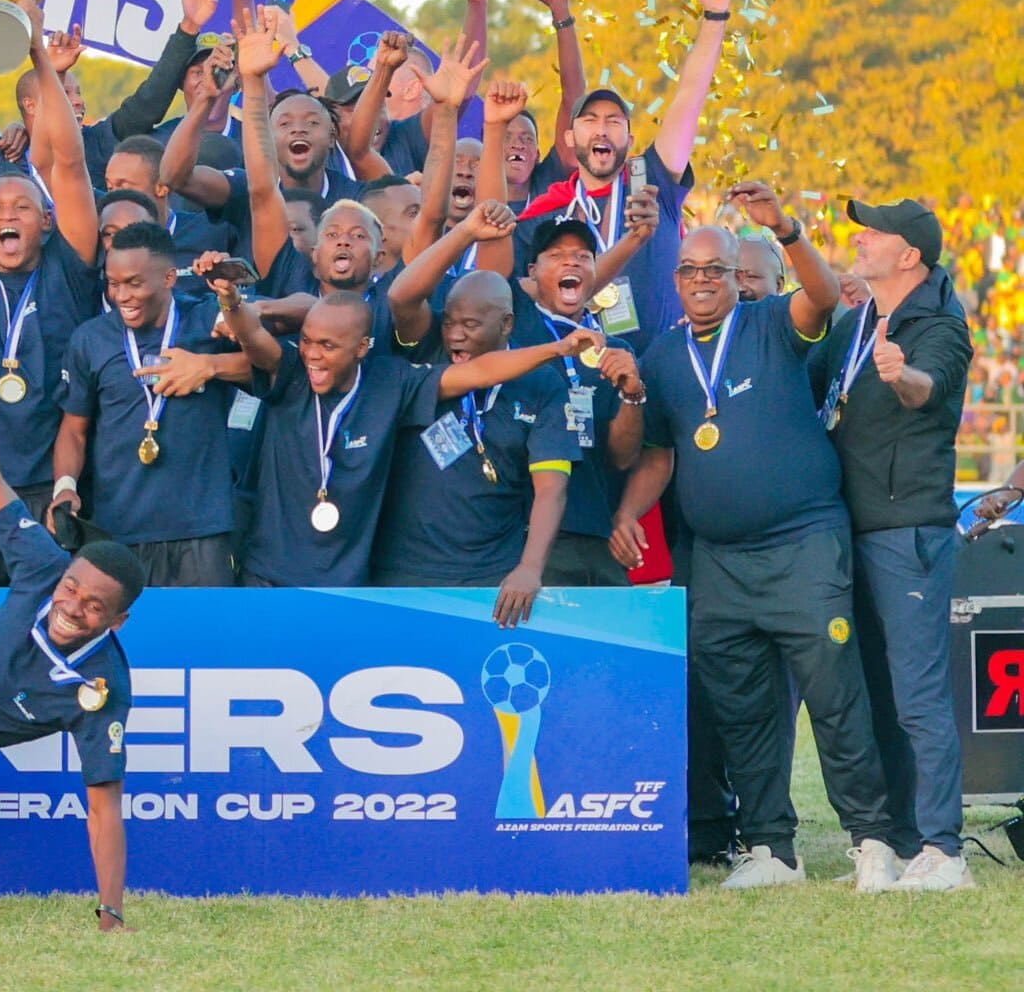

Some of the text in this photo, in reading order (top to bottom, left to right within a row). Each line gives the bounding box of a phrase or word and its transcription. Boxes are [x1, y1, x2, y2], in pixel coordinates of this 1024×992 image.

[634, 781, 666, 793] TFF
[216, 793, 315, 821] CUP
[332, 793, 457, 821] 2022
[545, 794, 659, 819] ASFC
[495, 823, 664, 832] AZAM SPORTS FEDERATION CUP
